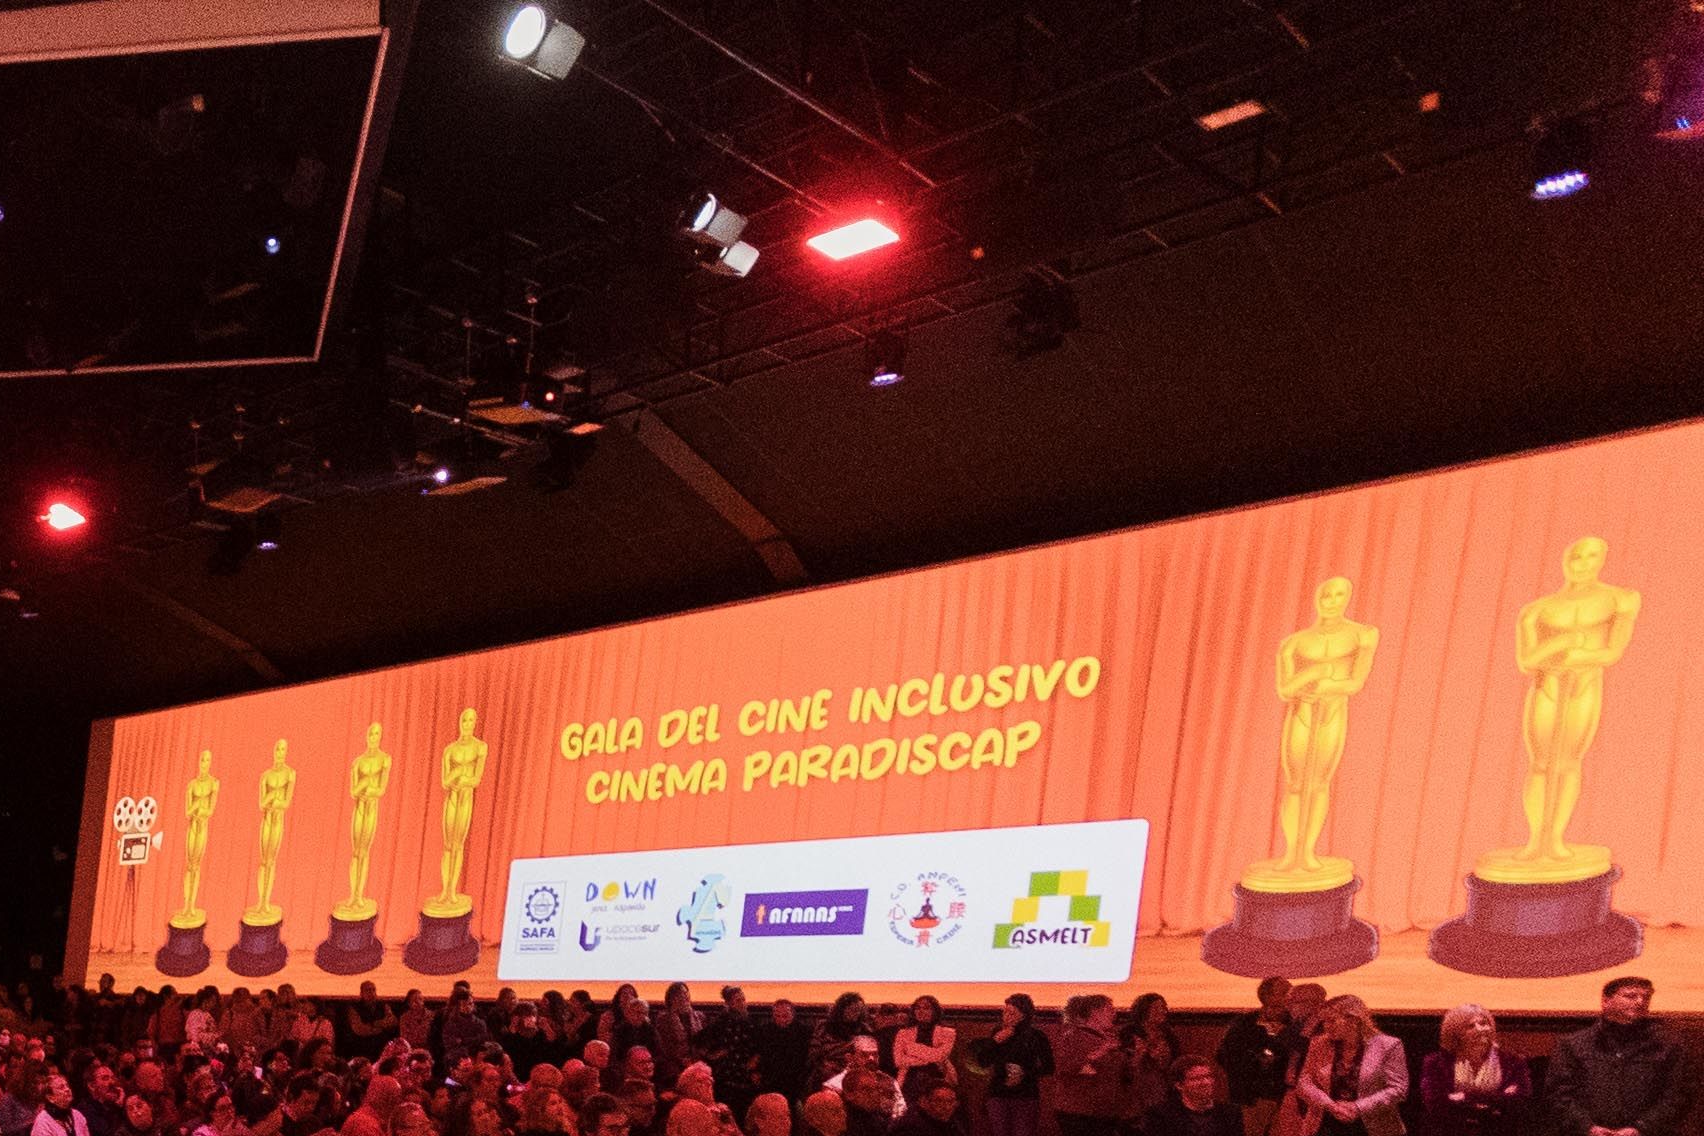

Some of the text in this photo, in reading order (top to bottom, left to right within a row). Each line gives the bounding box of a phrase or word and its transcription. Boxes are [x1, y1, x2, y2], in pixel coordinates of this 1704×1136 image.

[560, 656, 1102, 760] GALA DEL CINE INCLUSIVO
[585, 720, 1042, 804] CINEMA PARADISCAP
[586, 878, 657, 902] DOWN
[521, 927, 556, 939] SAFA
[1011, 926, 1092, 944] ASMELT
